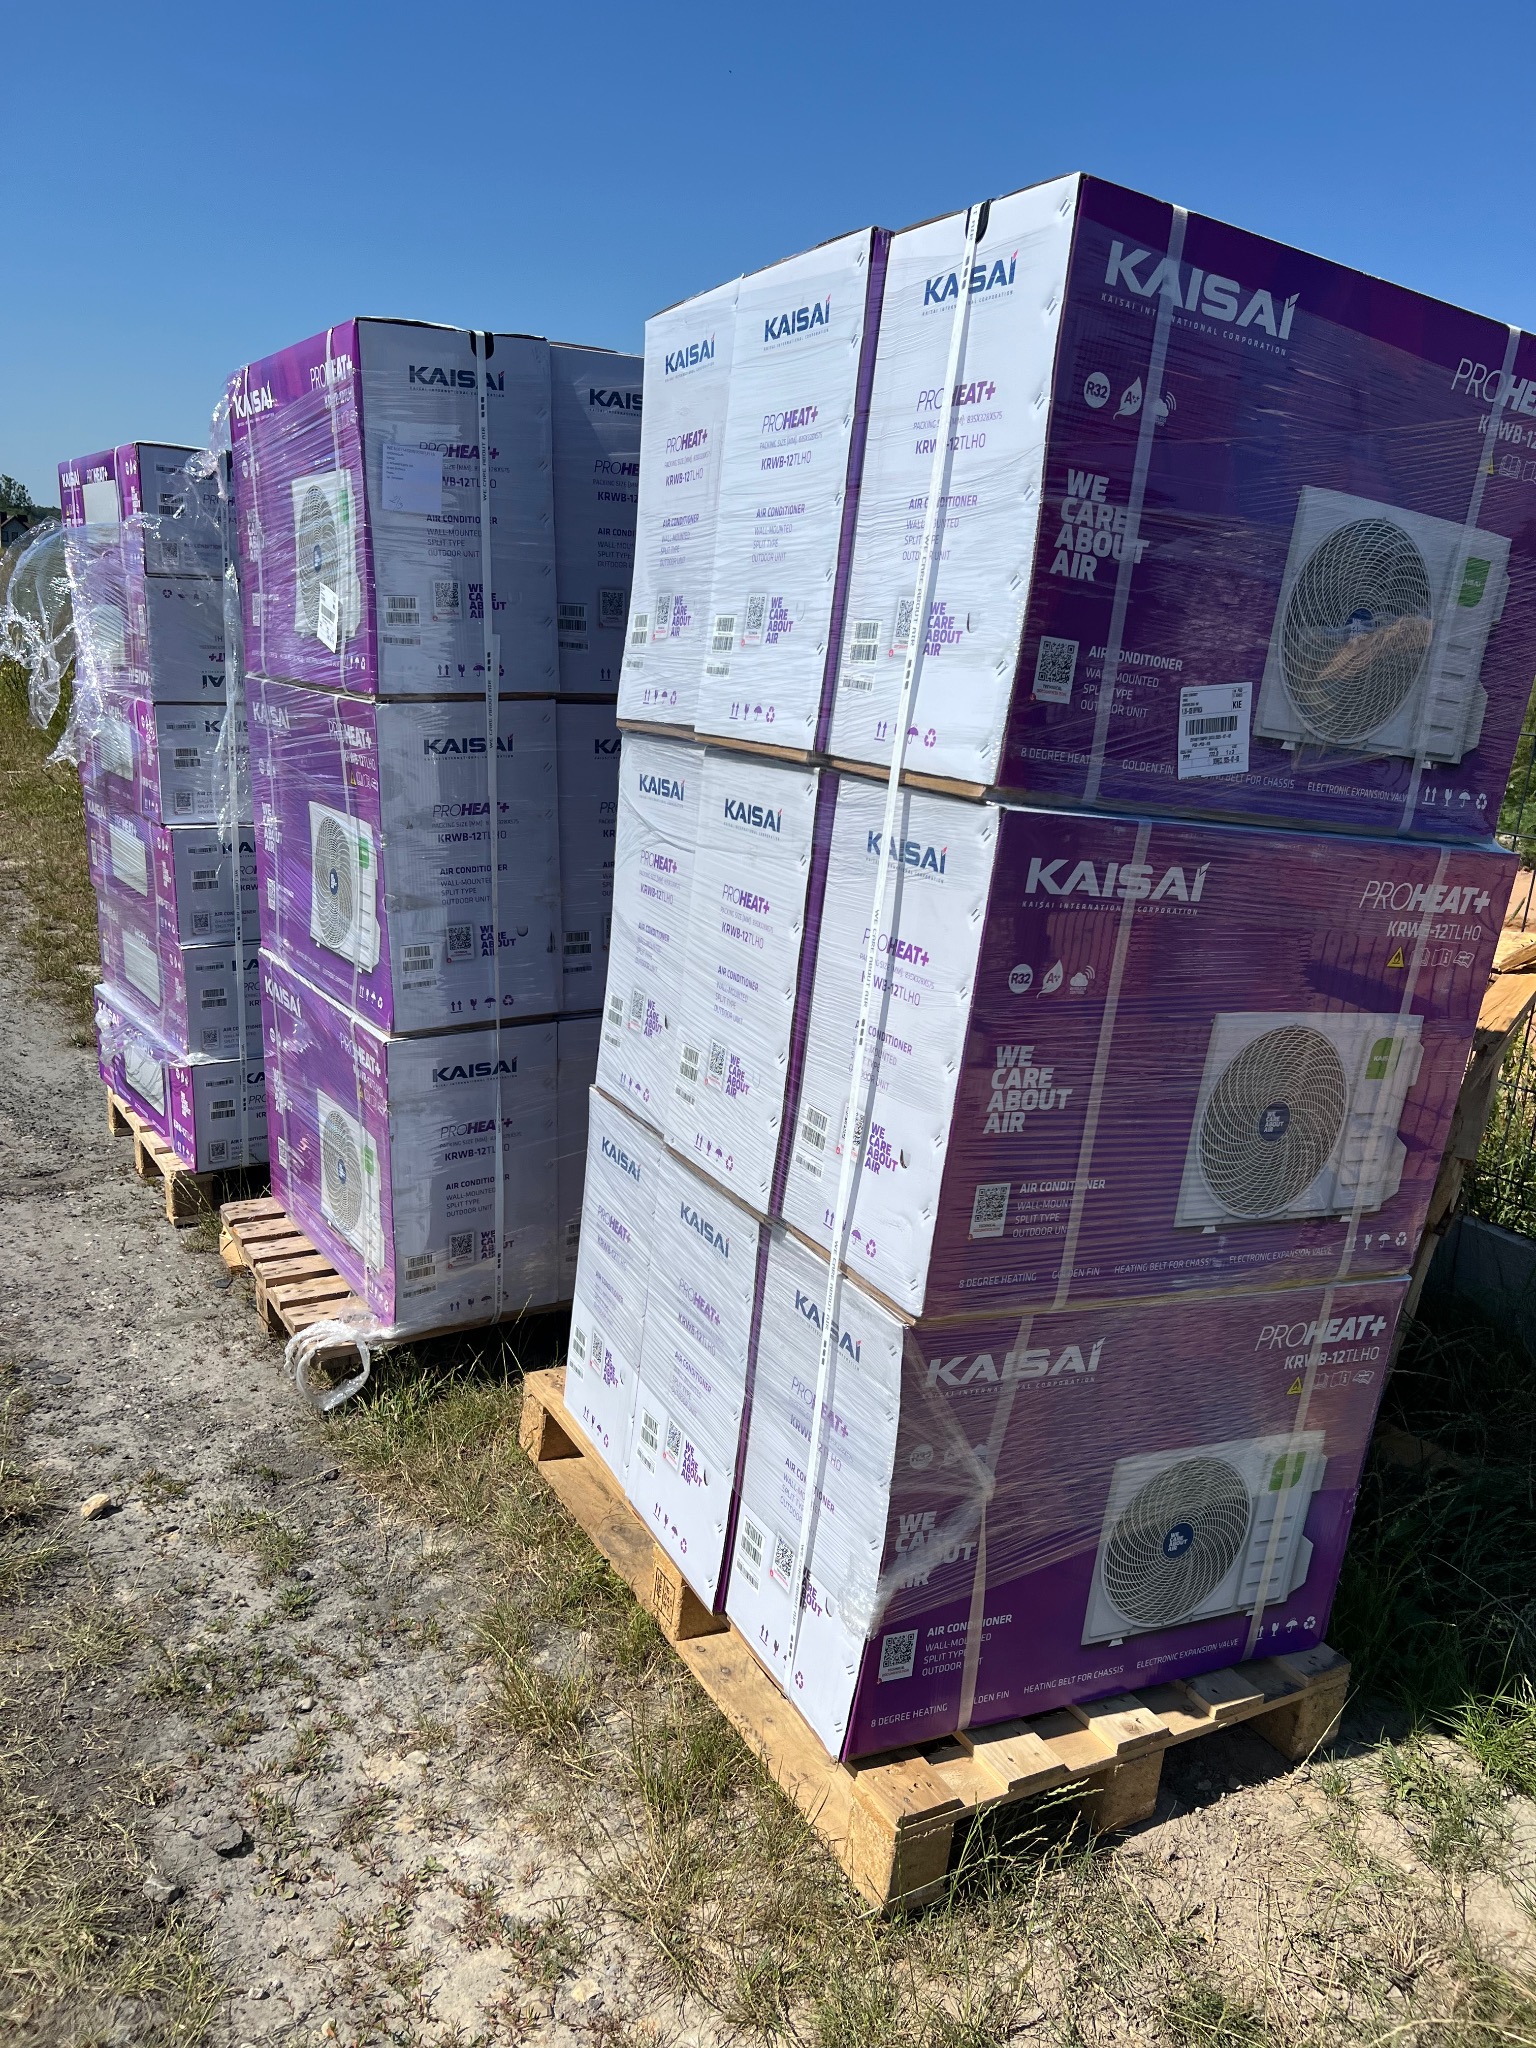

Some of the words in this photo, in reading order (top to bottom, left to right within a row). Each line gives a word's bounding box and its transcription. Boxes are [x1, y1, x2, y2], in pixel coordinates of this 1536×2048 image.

[1086, 382, 1108, 399] R32
[762, 406, 818, 434] PROHEAT+
[666, 429, 708, 453] PROHEAT+
[1067, 469, 1109, 503] WE
[1060, 497, 1128, 533] CARE
[1054, 524, 1150, 564] ABOUT
[1050, 552, 1098, 581] AIR
[674, 596, 683, 605] WE
[771, 597, 782, 608] WE
[673, 606, 687, 615] CARE
[769, 609, 788, 620] CARE
[930, 602, 946, 615] WE
[672, 616, 691, 626] ABOUT
[767, 621, 793, 632] ABOUT
[928, 616, 955, 629] CARE
[670, 627, 680, 636] AIR
[766, 633, 778, 643] AIR
[925, 630, 963, 644] ABOUT
[922, 644, 941, 656] AIR
[1233, 701, 1242, 709] KIE
[1021, 747, 1027, 757] 8
[722, 884, 770, 914] PROHEAT+
[1359, 880, 1491, 914] PROHEAT+
[1010, 972, 1031, 984] R32
[730, 1054, 741, 1066] WE
[997, 1045, 1035, 1067] WE
[729, 1065, 745, 1080] CARE
[991, 1067, 1055, 1089] CARE
[726, 1085, 737, 1099] AIR
[727, 1076, 750, 1095] ABOUT
[986, 1089, 1073, 1112] ABOUT
[871, 1122, 886, 1139] WE
[982, 1112, 1025, 1134] AIR
[869, 1135, 892, 1156] CARE
[865, 1158, 880, 1175] AIR
[866, 1146, 898, 1172] ABOUT
[1020, 1183, 1037, 1193] AIR
[959, 1280, 964, 1288] 8
[966, 1277, 999, 1288] DEGREE
[1255, 1315, 1387, 1351] PROHEAT+
[899, 1511, 937, 1534] WE
[927, 1626, 944, 1637] AIR
[923, 1653, 946, 1664] SPLIT
[1136, 1652, 1178, 1669] ELECTRONIC
[1179, 1642, 1218, 1658] EXPANSION
[1219, 1638, 1239, 1649] VALVE
[922, 1662, 961, 1676] OUTDOOR
[1023, 1679, 1057, 1694] HEATING
[1058, 1674, 1076, 1687] BELT
[1077, 1672, 1093, 1683] FOR
[1093, 1665, 1124, 1680] CHASSIS
[997, 1690, 1010, 1701] FIN
[871, 1718, 876, 1728] 8
[878, 1712, 910, 1727] DEGREE
[913, 1703, 948, 1718] HEATING
